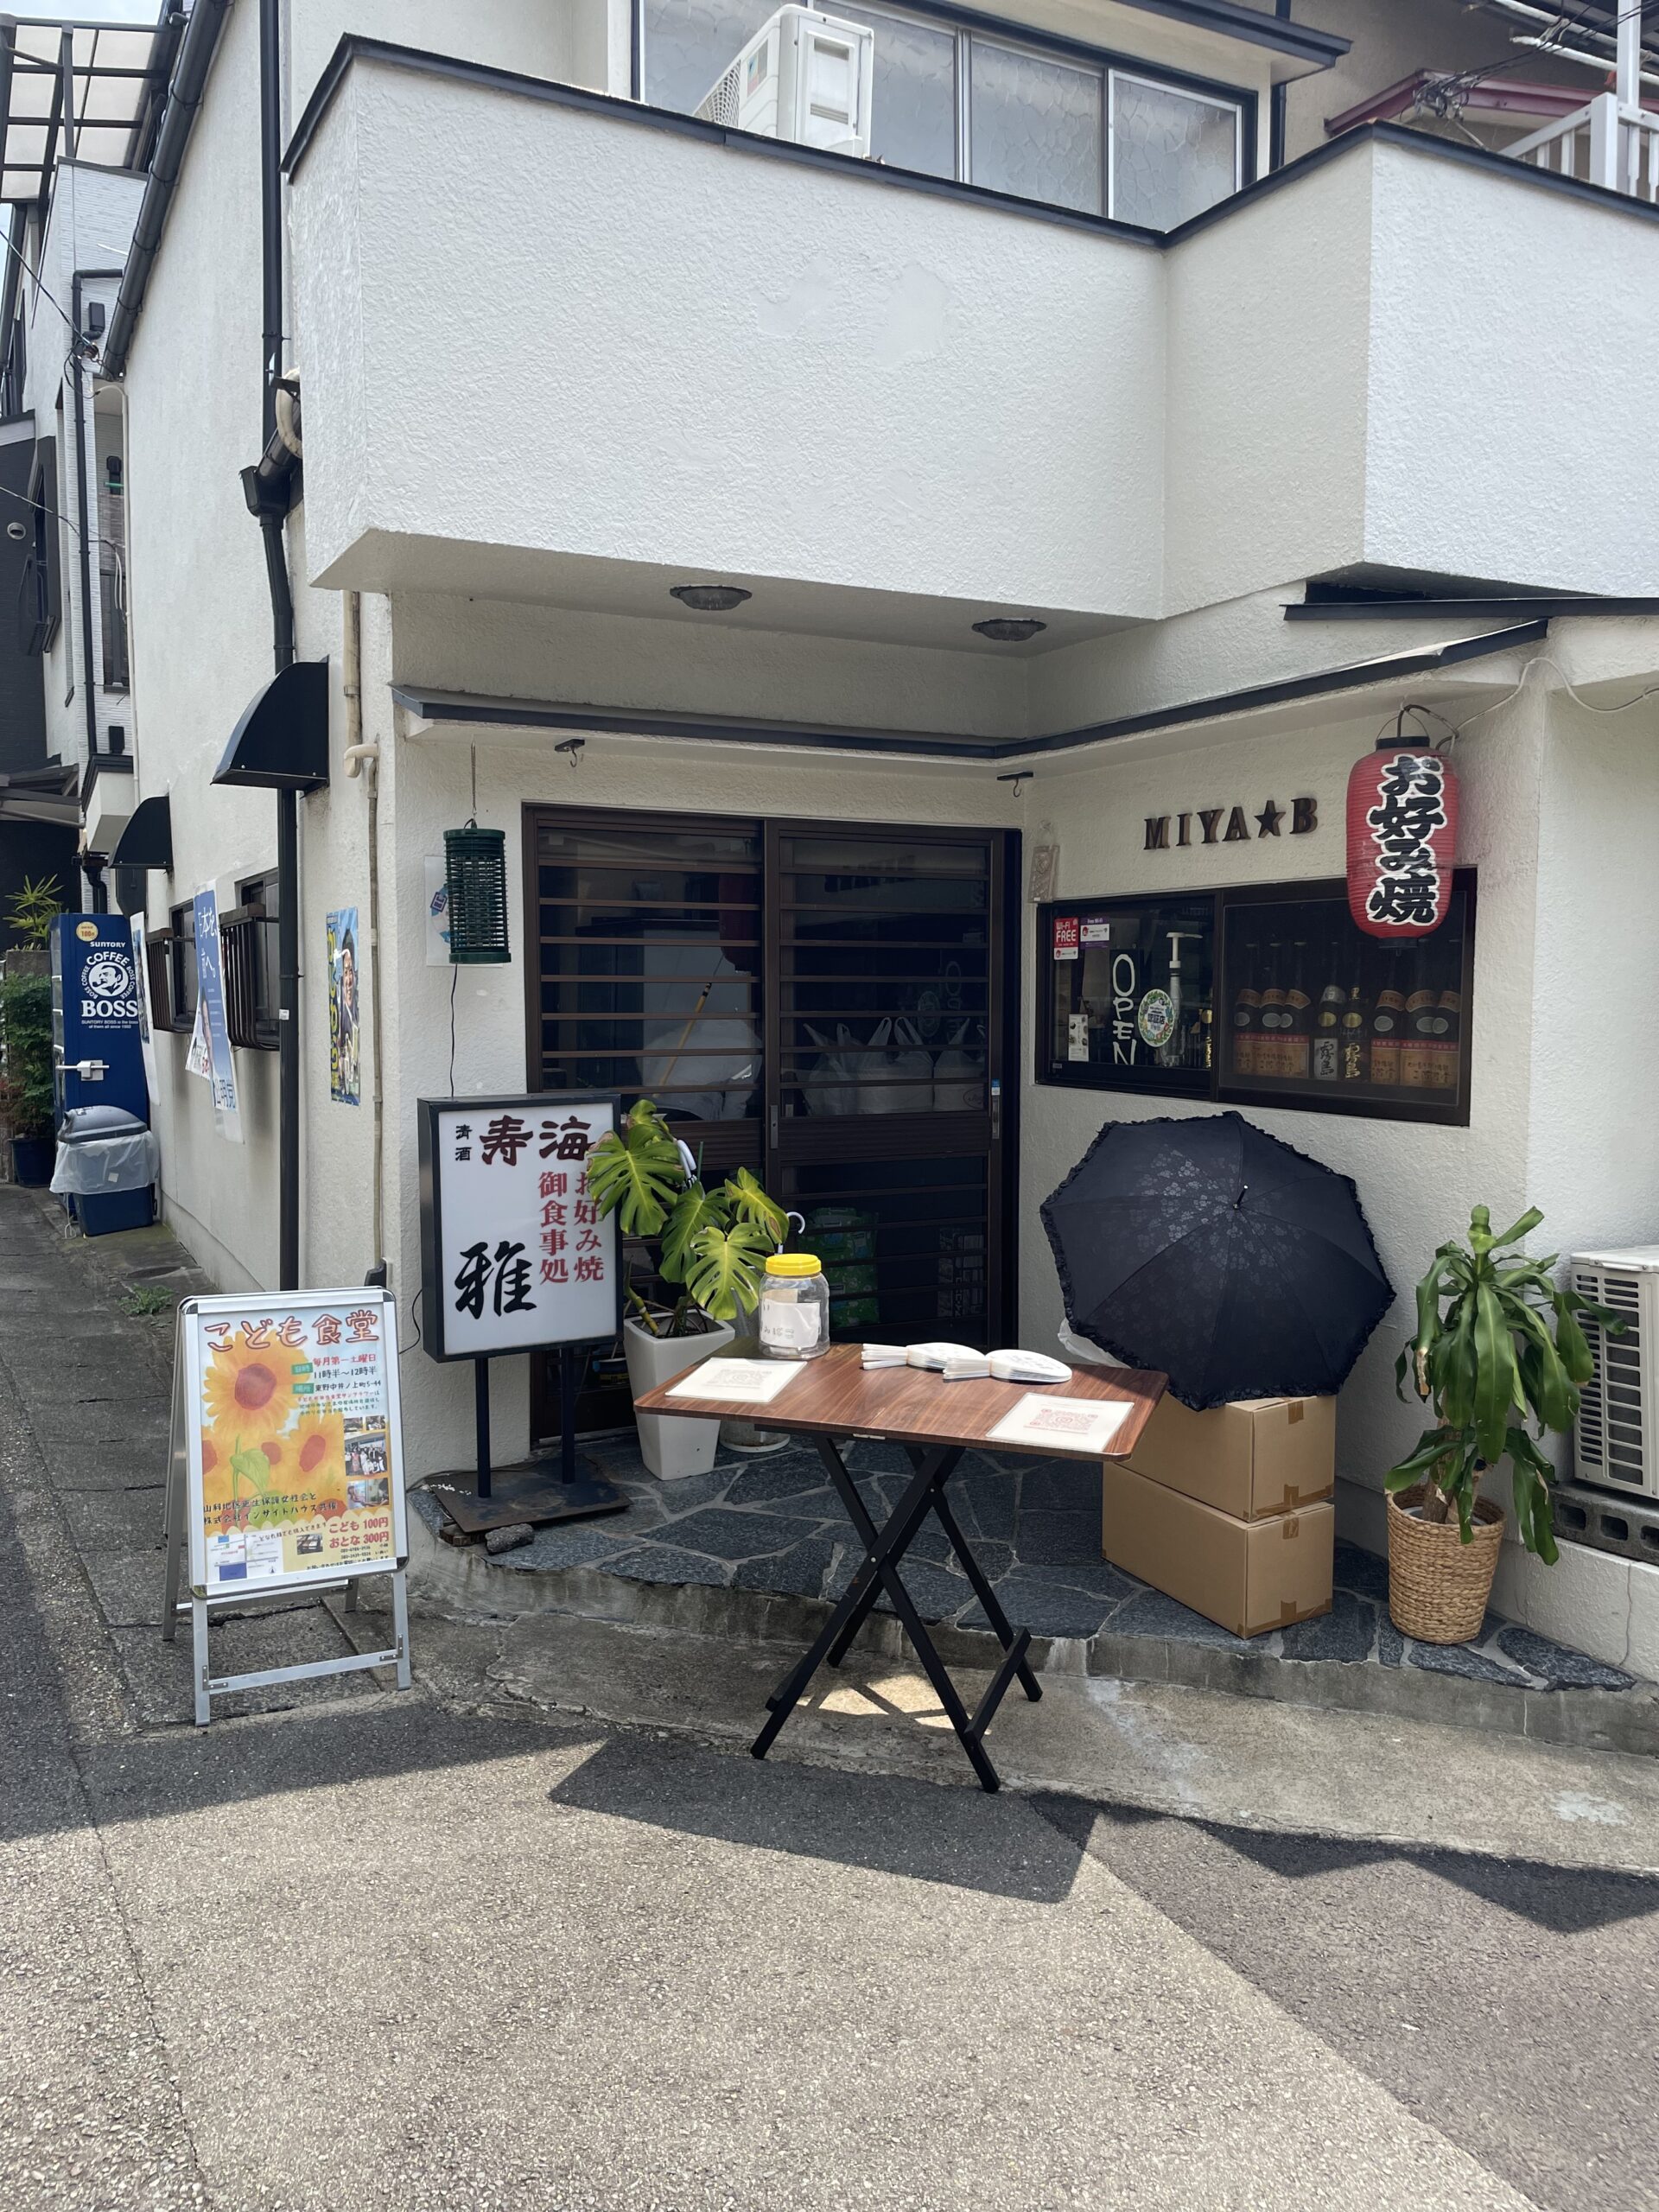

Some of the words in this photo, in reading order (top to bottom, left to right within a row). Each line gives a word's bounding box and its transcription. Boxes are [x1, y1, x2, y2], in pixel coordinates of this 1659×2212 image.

[1367, 754, 1446, 925] お好み焼
[1056, 921, 1071, 931] Wi-Fi
[1056, 929, 1077, 943] FREE
[86, 950, 130, 967] COFFEE
[80, 1000, 138, 1018] BOSS
[1112, 953, 1137, 1065] OPEN
[537, 1171, 569, 1286] 御食事処
[454, 1240, 537, 1320] 雅
[204, 1309, 380, 1352] こども食堂
[329, 1520, 359, 1535] こども
[363, 1516, 389, 1529] 100円
[329, 1535, 360, 1548] おとな
[363, 1531, 390, 1544] 300円
